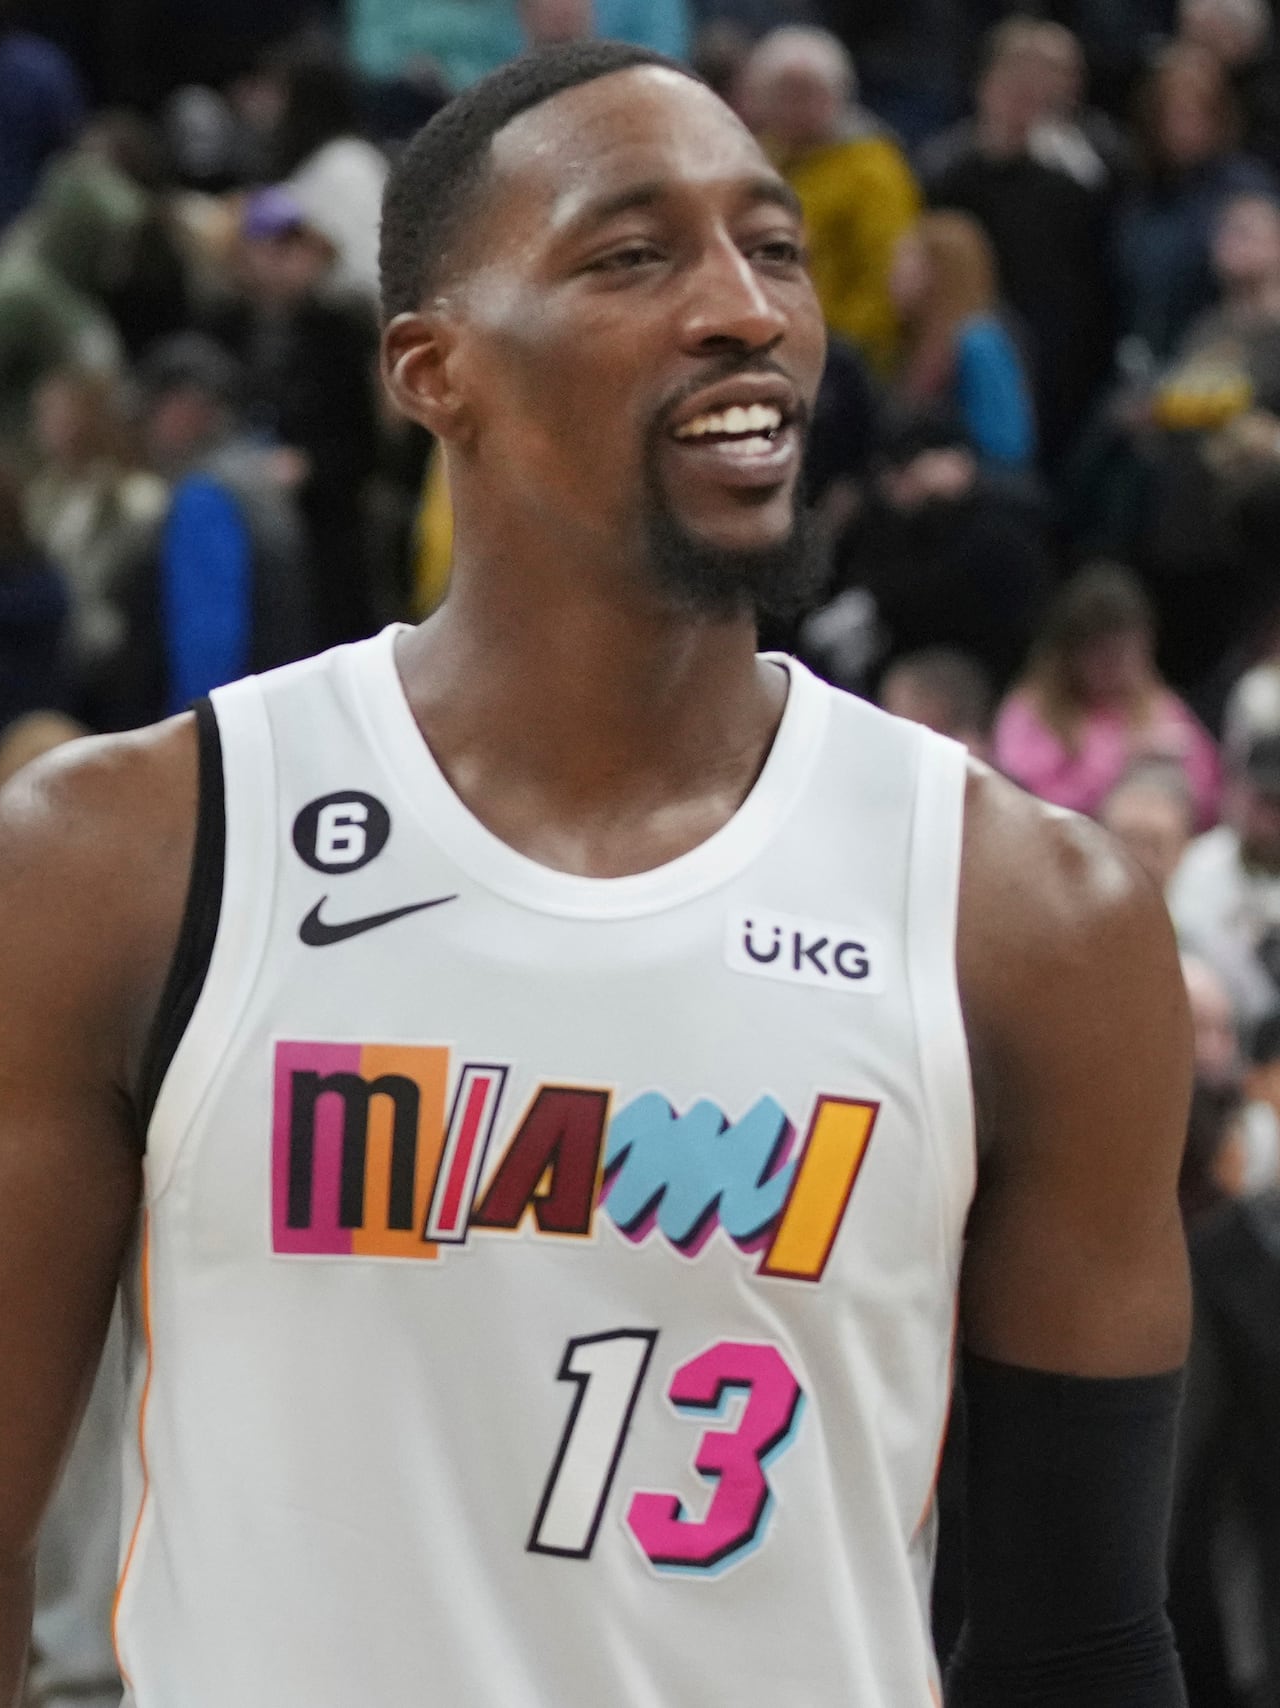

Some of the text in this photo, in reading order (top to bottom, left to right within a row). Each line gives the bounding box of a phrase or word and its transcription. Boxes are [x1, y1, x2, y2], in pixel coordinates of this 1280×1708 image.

[314, 802, 369, 865] 6
[272, 1040, 881, 1283] MIAMI
[526, 1328, 807, 1577] 13
